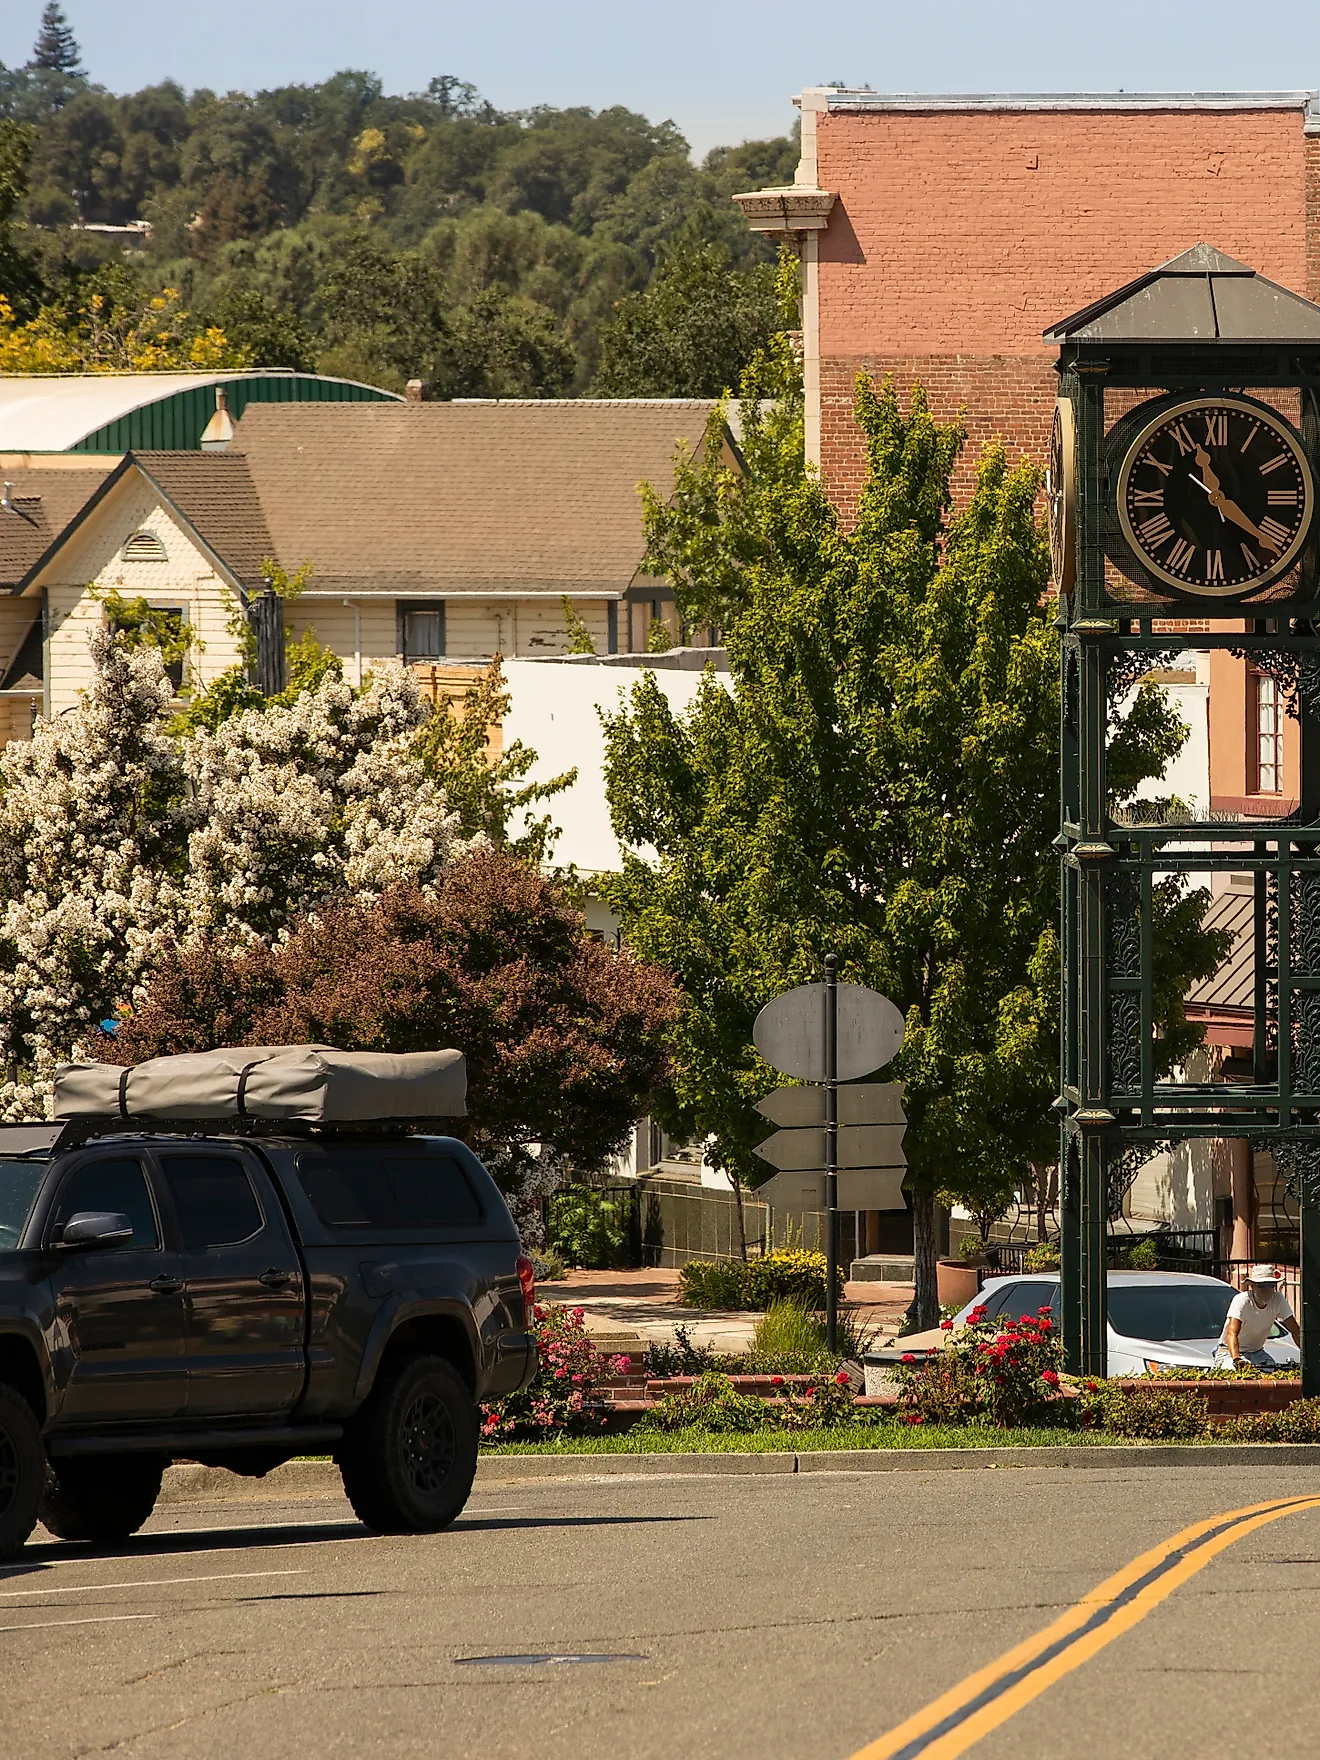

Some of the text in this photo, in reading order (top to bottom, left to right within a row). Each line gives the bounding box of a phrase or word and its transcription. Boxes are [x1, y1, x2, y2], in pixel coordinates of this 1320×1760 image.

[1168, 422, 1196, 456] XI
[1205, 416, 1228, 446] XII
[1143, 452, 1174, 477] X
[1258, 452, 1288, 476] II
[1134, 488, 1164, 506] IX
[1267, 490, 1298, 506] III
[1206, 550, 1224, 580] VI
[1240, 542, 1260, 571] V
